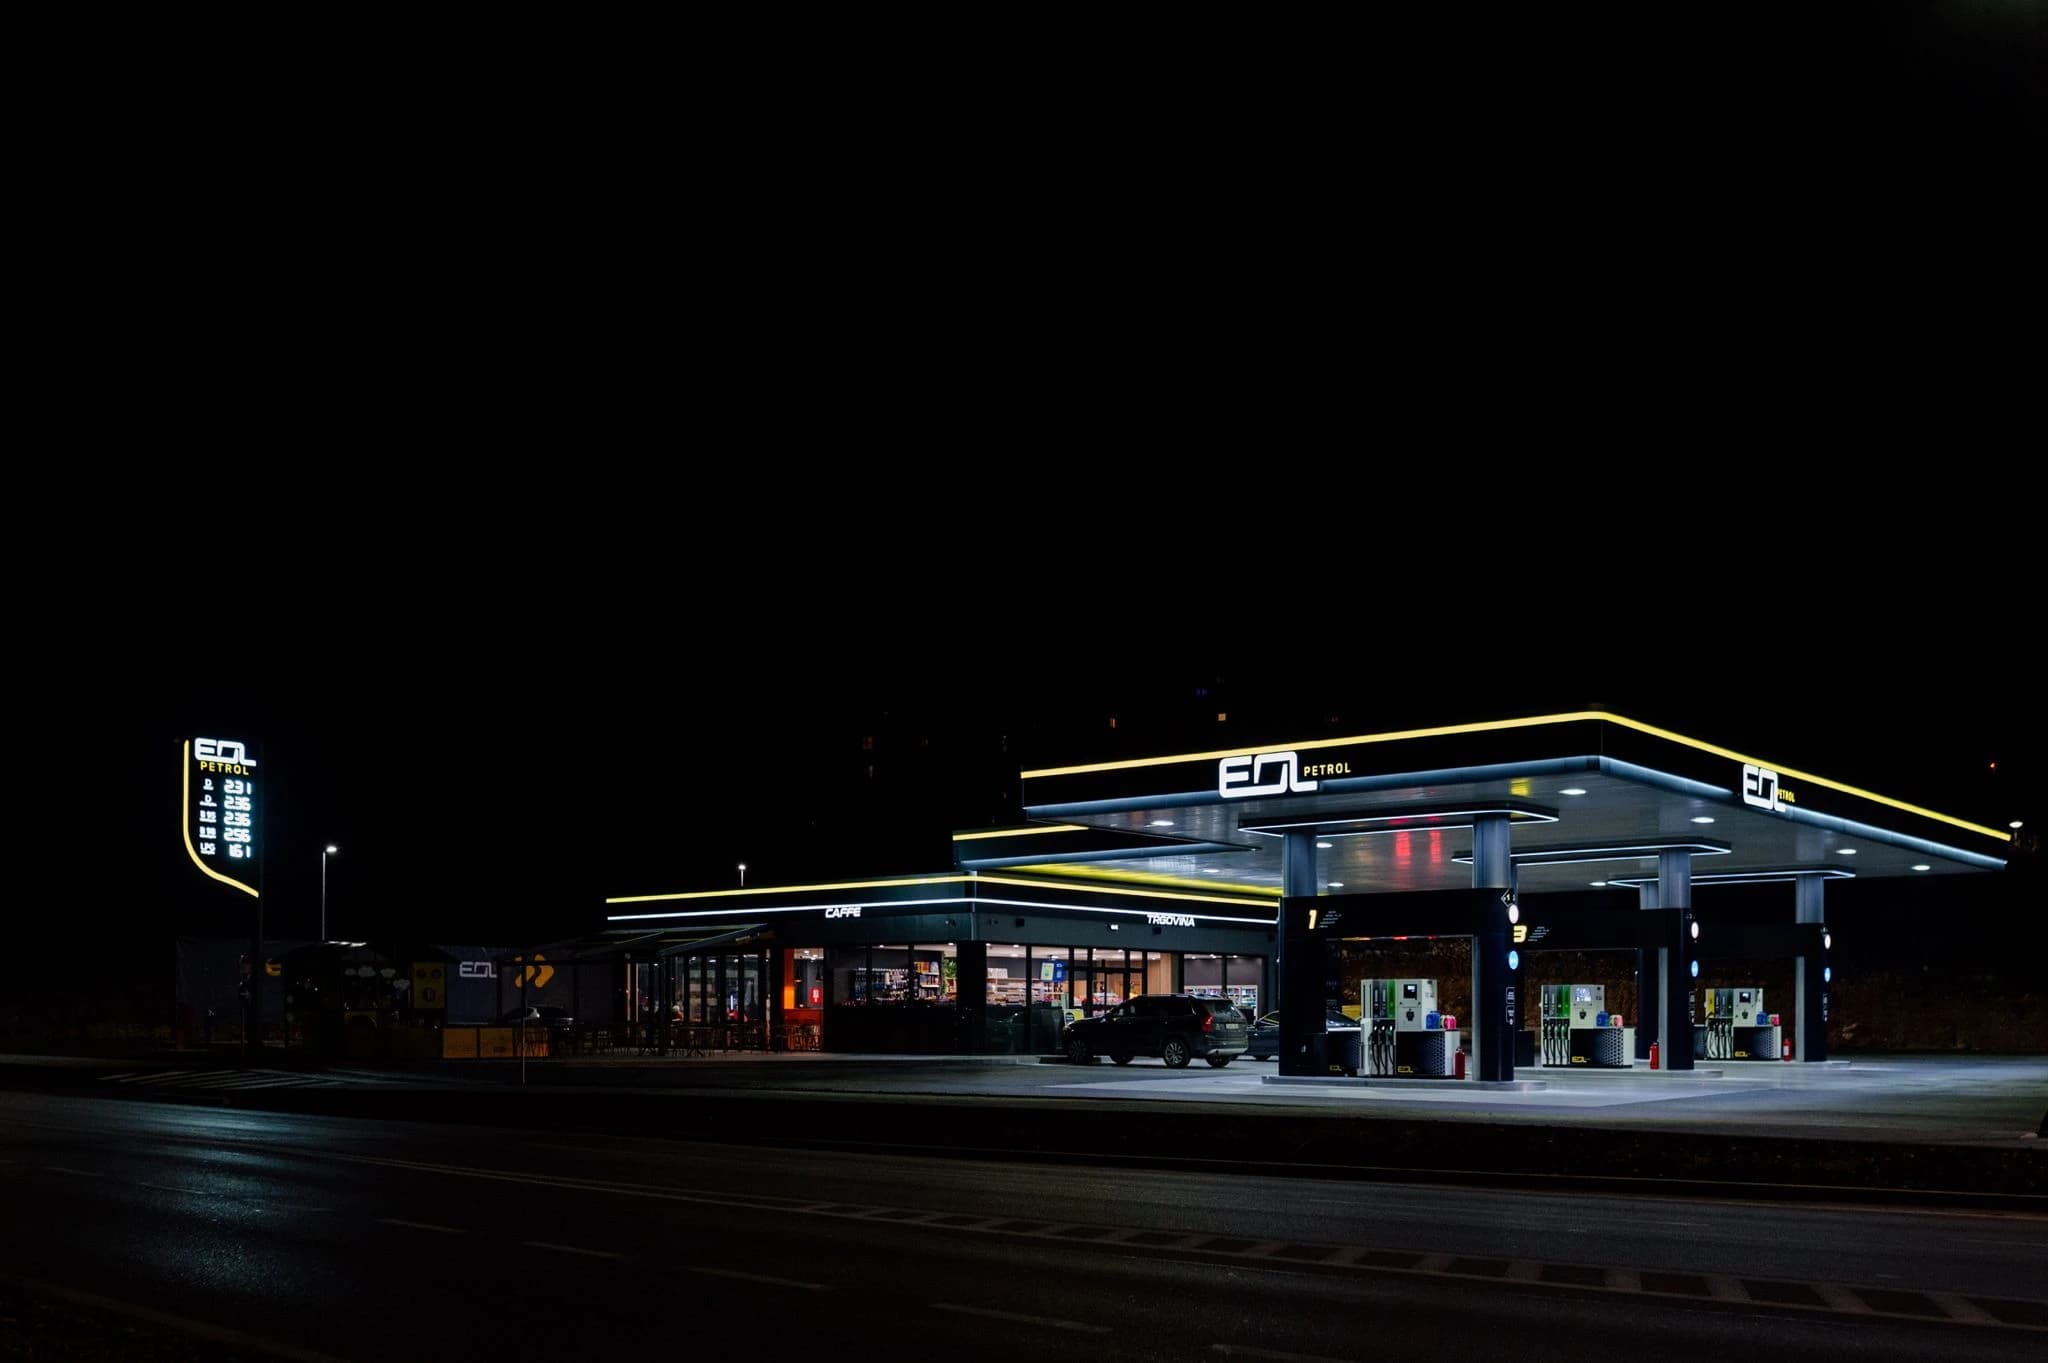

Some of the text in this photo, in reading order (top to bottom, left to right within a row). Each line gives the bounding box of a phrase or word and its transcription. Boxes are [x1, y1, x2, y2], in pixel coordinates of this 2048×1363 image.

[200, 761, 249, 775] PETROL
[1303, 762, 1352, 776] PETROL
[1308, 908, 1318, 930] 1
